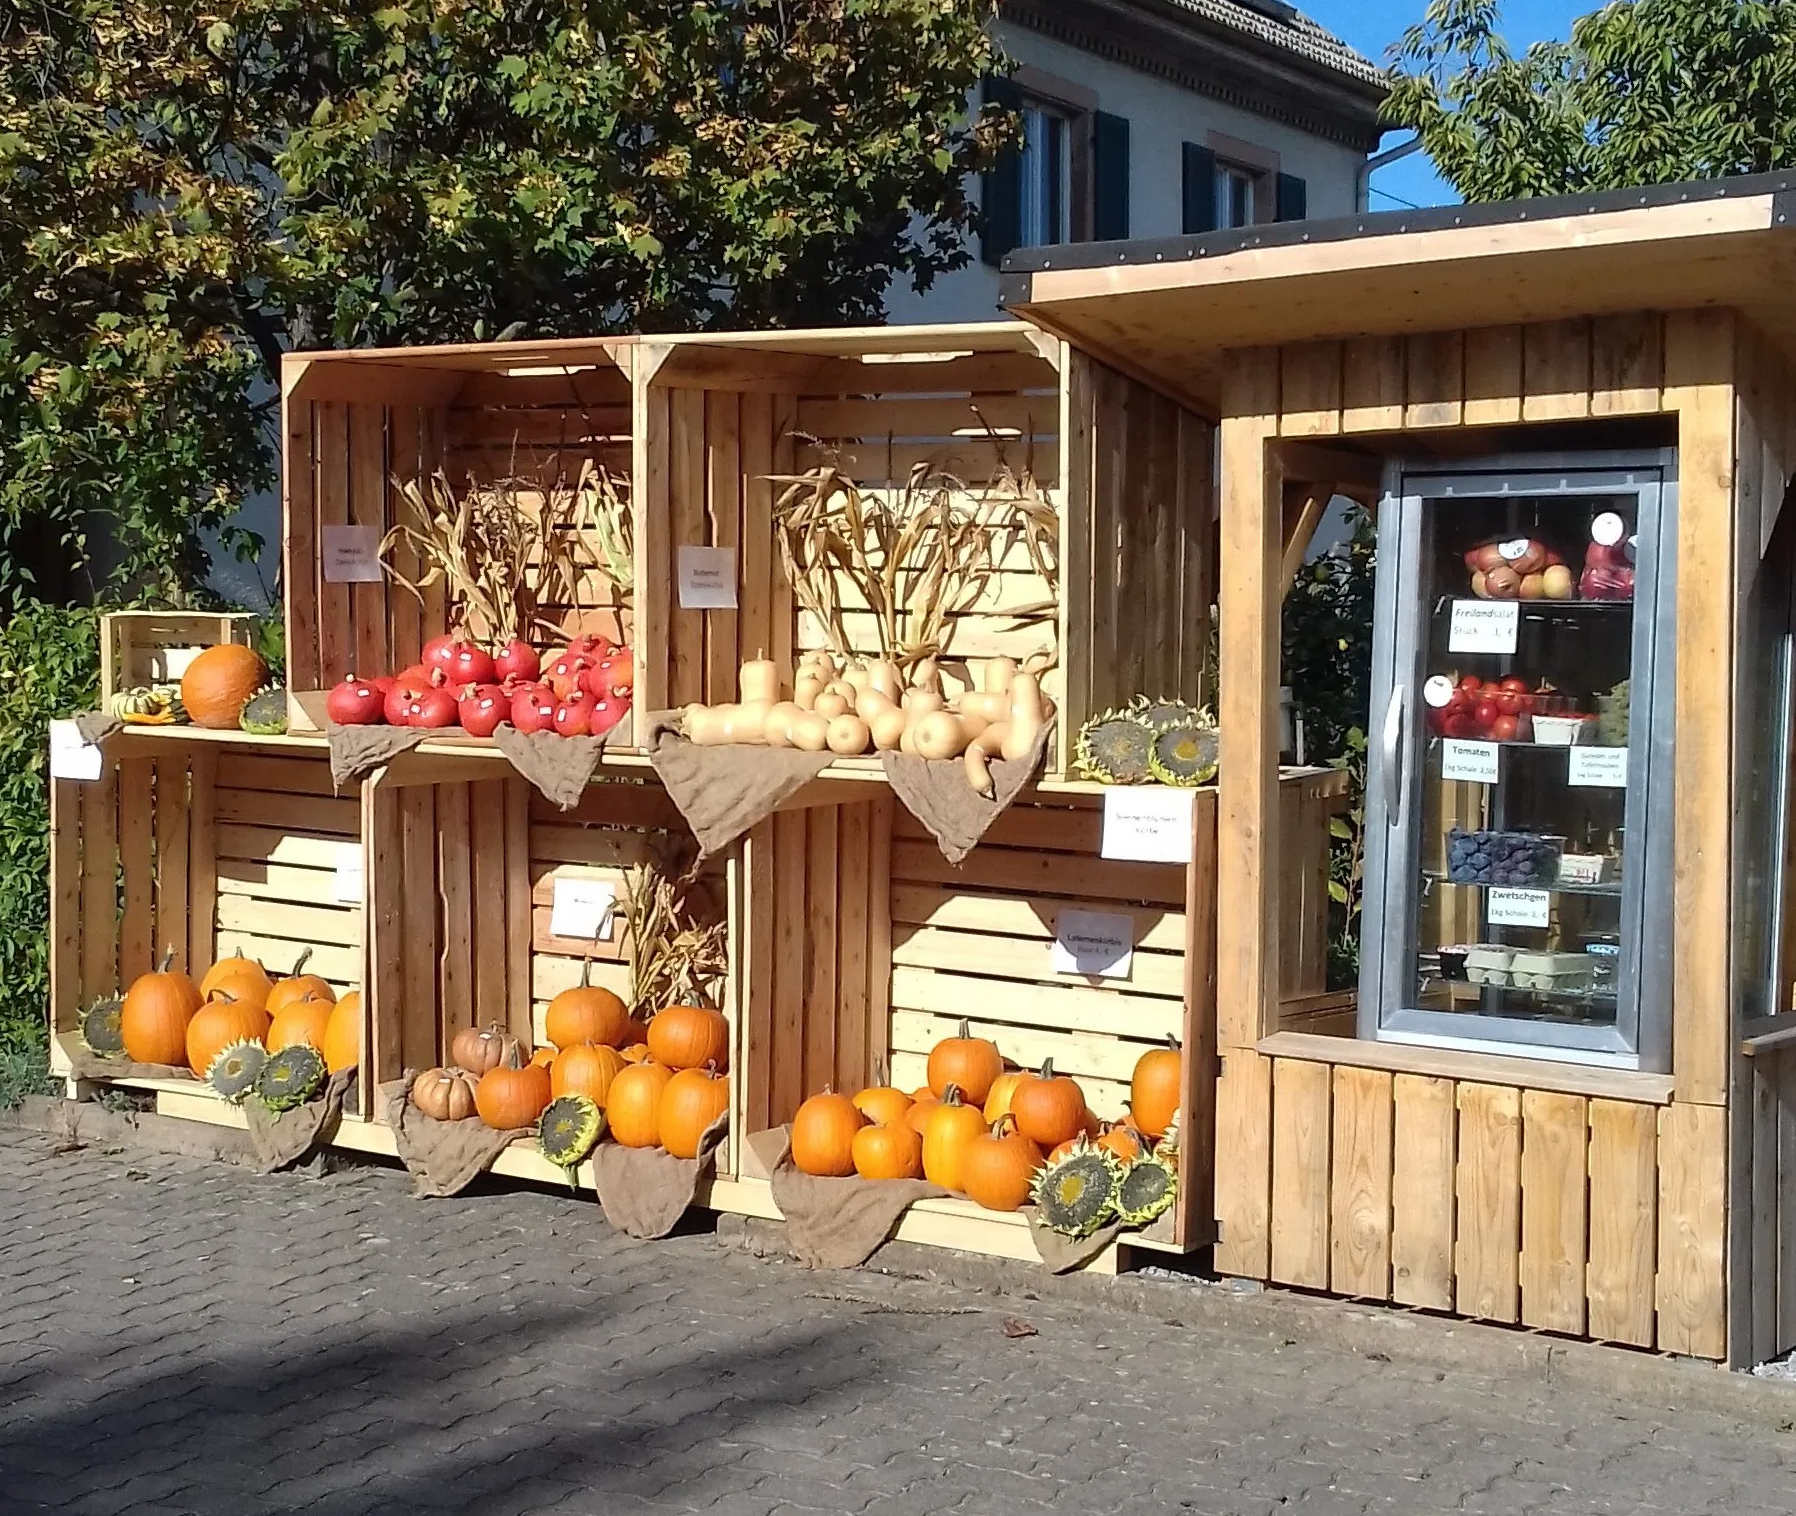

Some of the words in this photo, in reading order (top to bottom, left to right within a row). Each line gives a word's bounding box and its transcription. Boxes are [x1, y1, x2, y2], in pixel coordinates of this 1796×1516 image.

[1455, 608, 1514, 618] Freilandsalat
[1452, 745, 1490, 757] Tomaten
[1491, 890, 1547, 903] Zwetschgen
